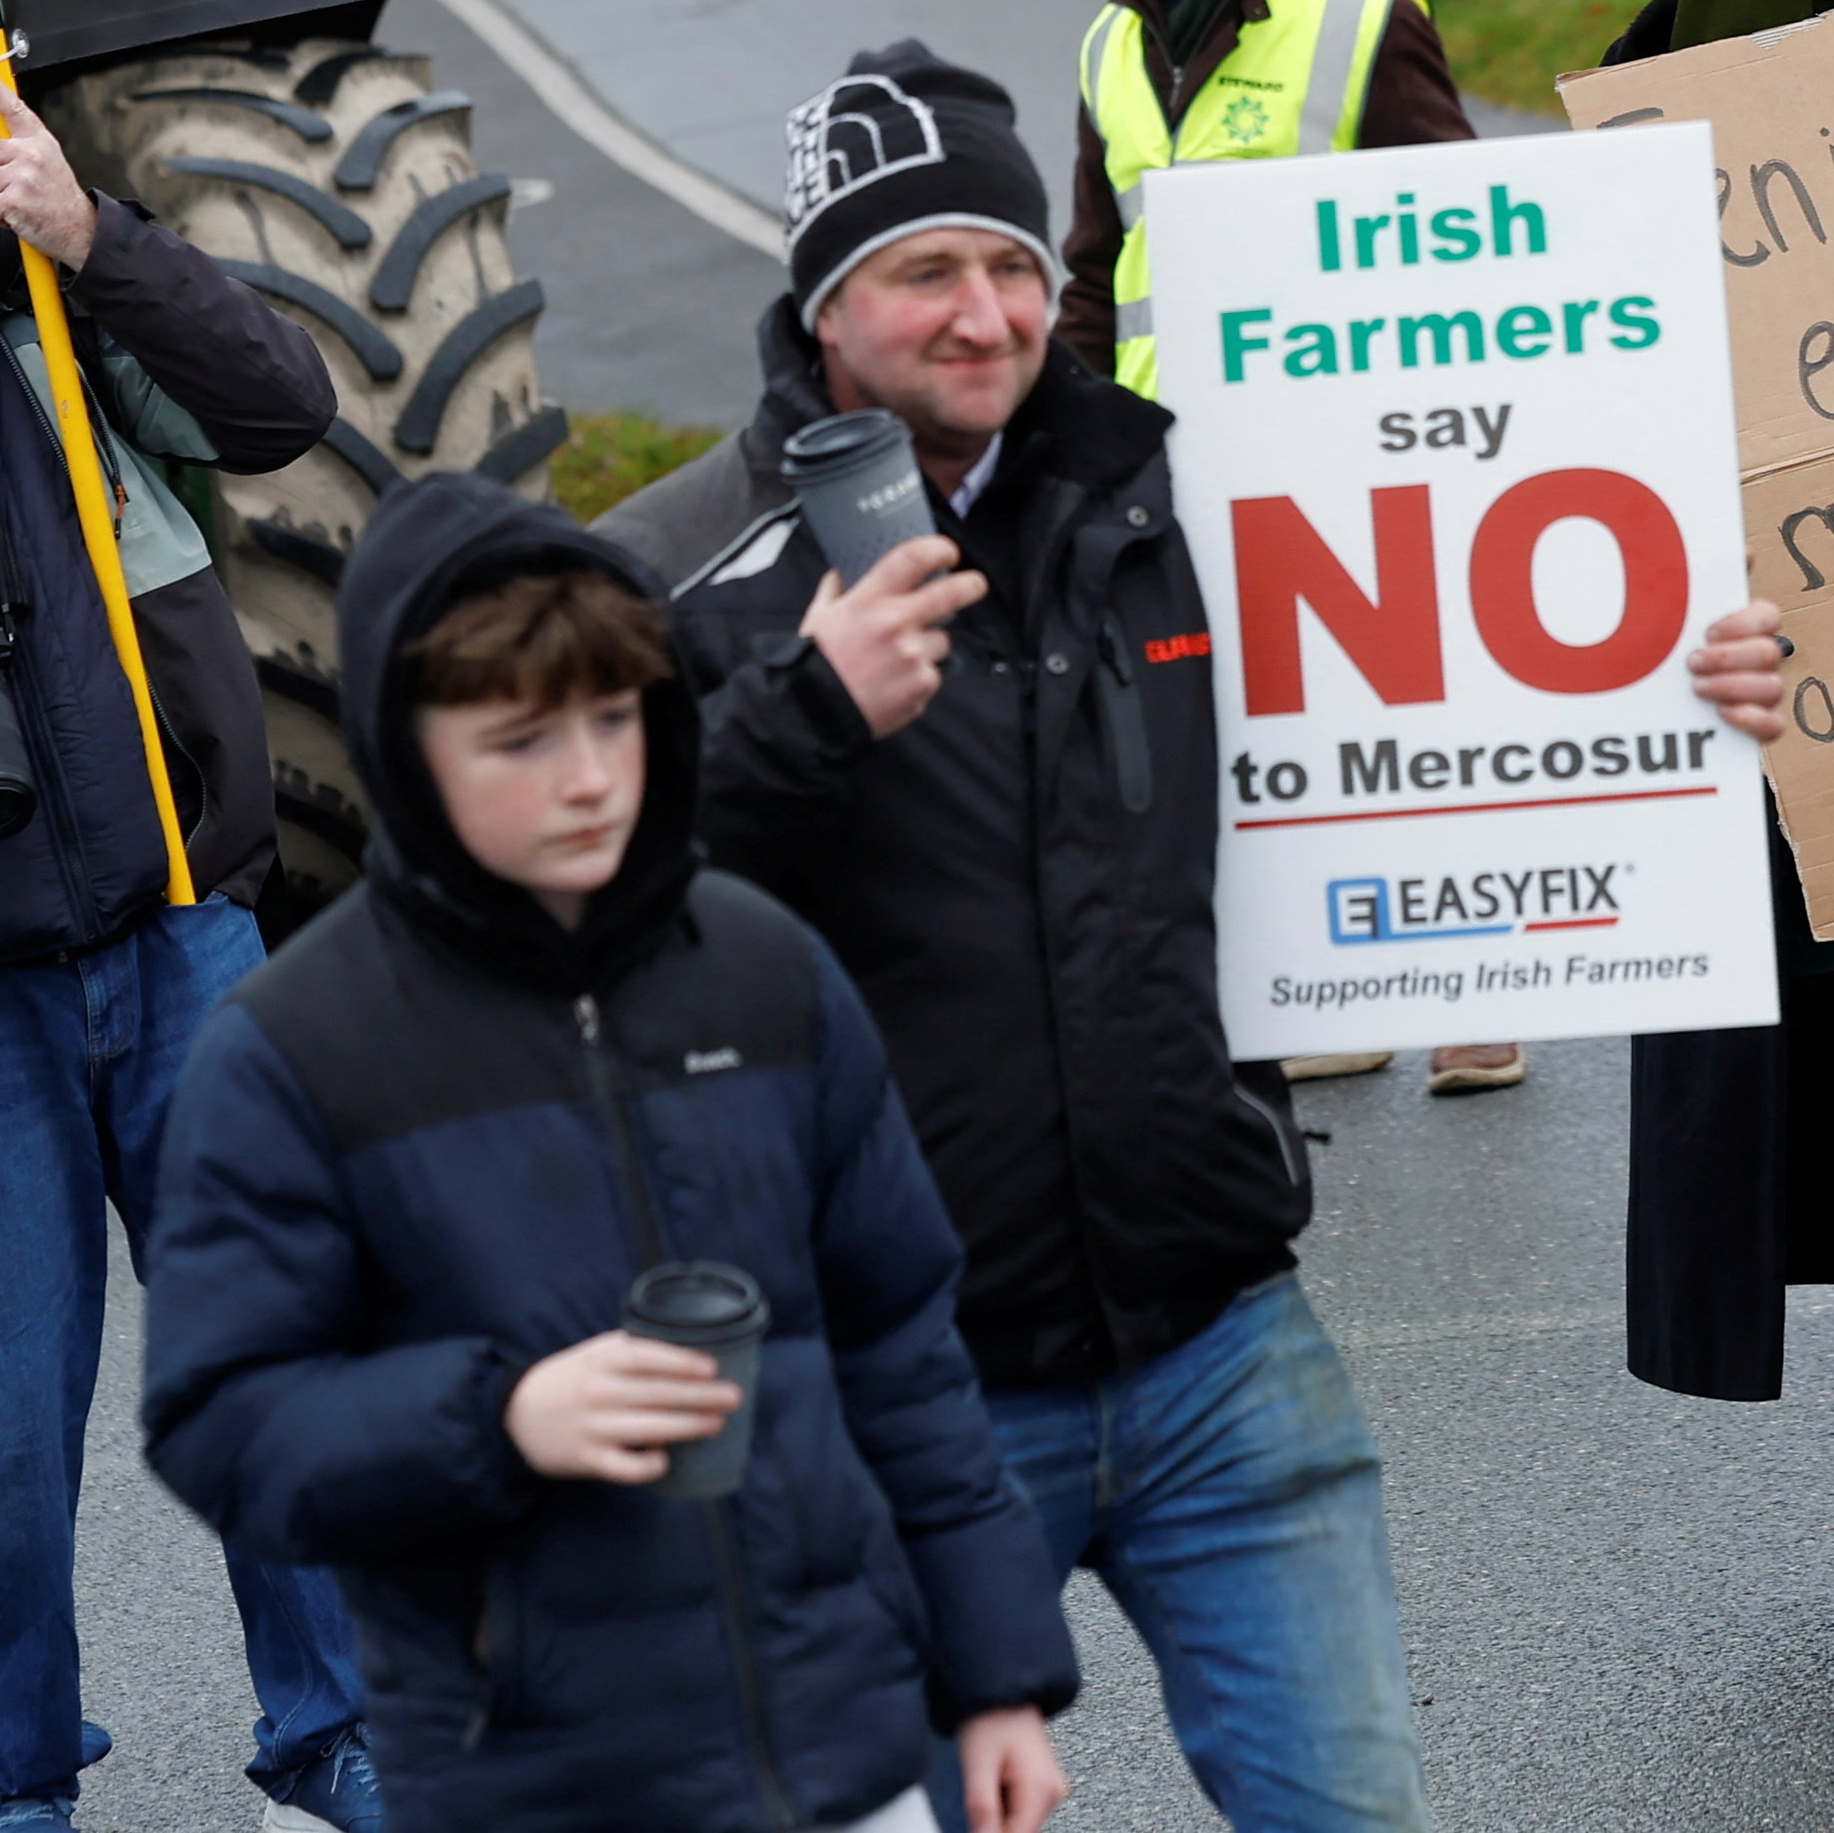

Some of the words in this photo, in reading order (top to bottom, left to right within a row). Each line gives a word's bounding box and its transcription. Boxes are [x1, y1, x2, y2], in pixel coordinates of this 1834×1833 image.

[1313, 182, 1550, 275] Irish
[1217, 293, 1664, 386] Farmers
[1377, 402, 1514, 462] say
[1227, 465, 1692, 721] NO
[1226, 748, 1311, 808] to
[1336, 727, 1718, 798] Mercosur
[1397, 863, 1620, 927] EASYFIX
[1269, 969, 1465, 1012] Supporting
[1474, 958, 1553, 992] Irish
[1564, 953, 1710, 985] Farmers
